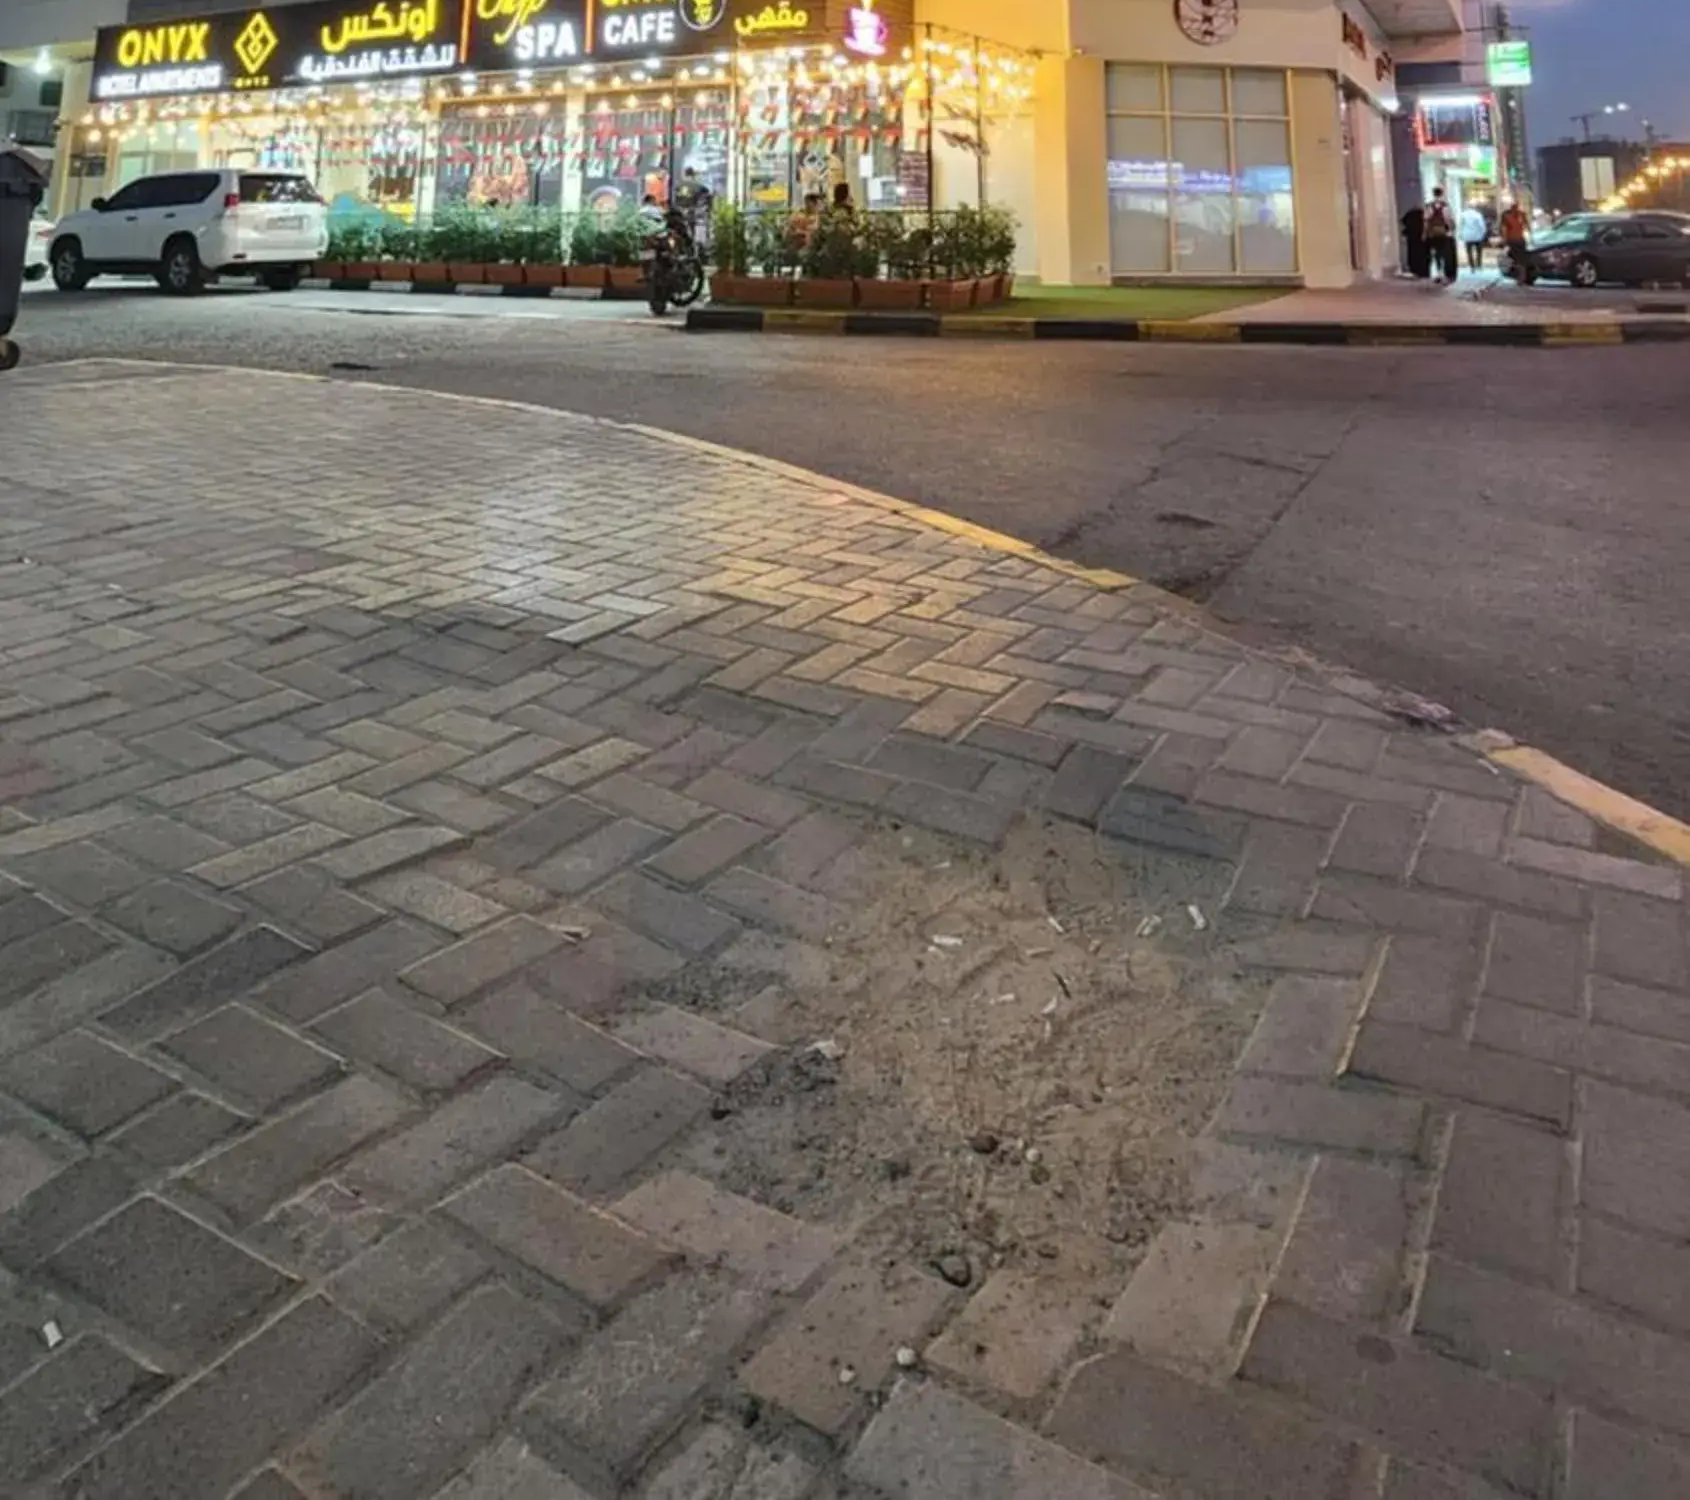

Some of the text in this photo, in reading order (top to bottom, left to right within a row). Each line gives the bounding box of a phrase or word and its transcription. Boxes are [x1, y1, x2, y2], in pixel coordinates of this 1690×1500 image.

[117, 22, 210, 68] ONYX
[514, 20, 577, 61] SPA
[603, 9, 677, 46] CAFE
